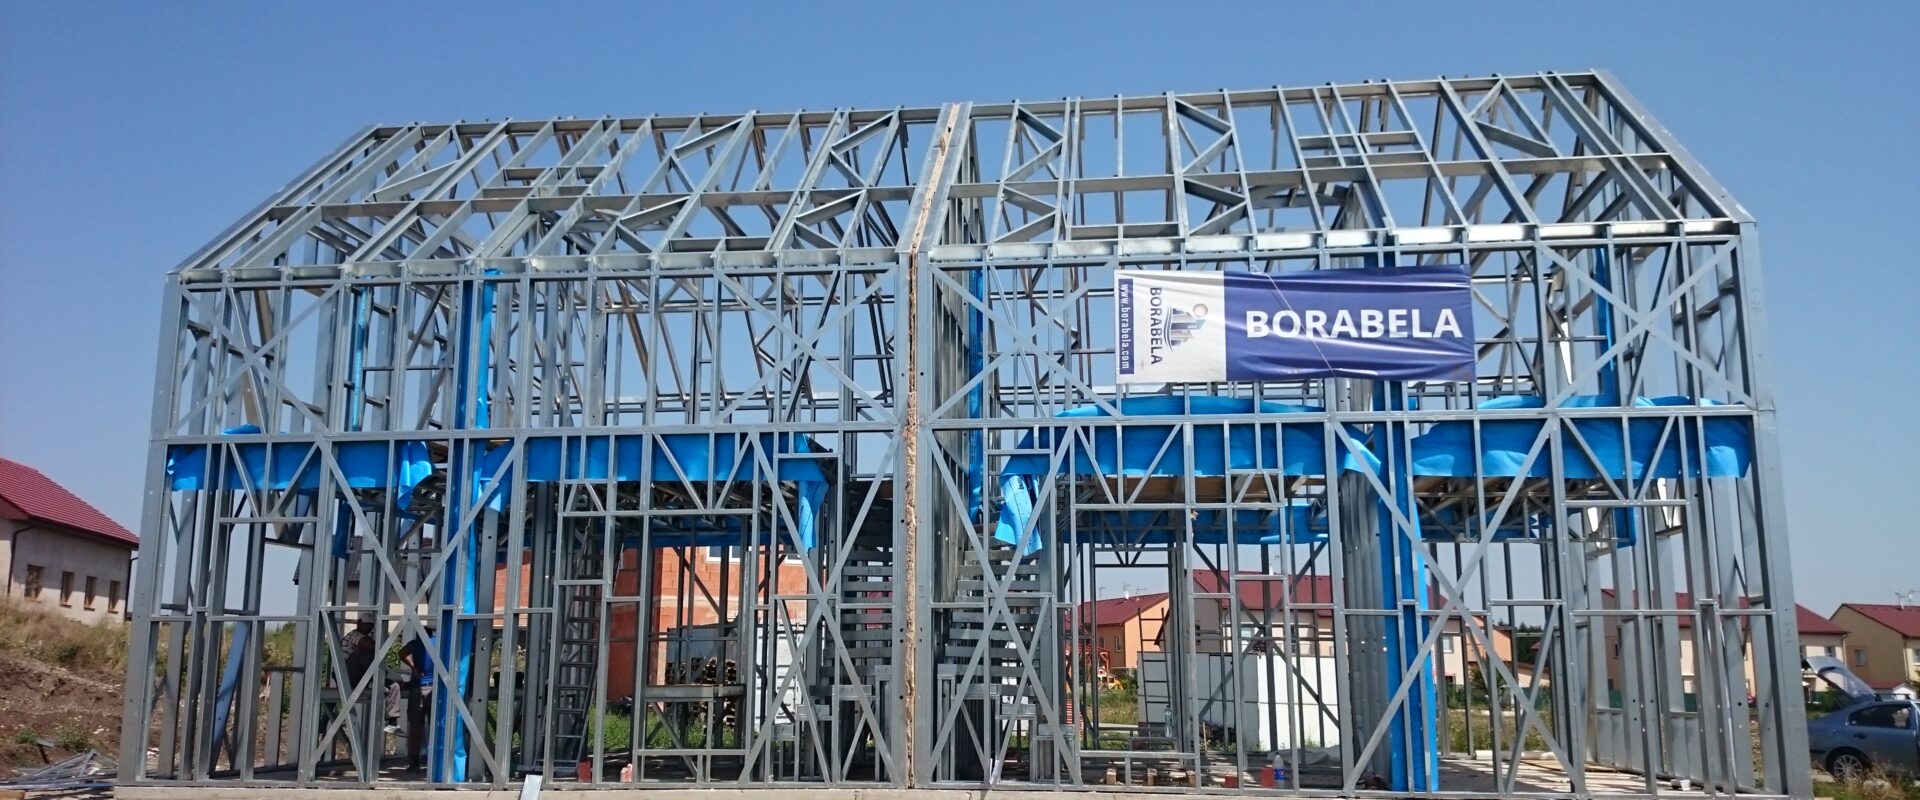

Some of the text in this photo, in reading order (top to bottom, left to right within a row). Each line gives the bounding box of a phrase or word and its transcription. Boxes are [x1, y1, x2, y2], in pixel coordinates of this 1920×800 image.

[1120, 284, 1131, 369] www.borabela.com
[1150, 287, 1163, 365] BORABELA
[1246, 308, 1463, 339] BORABELA
